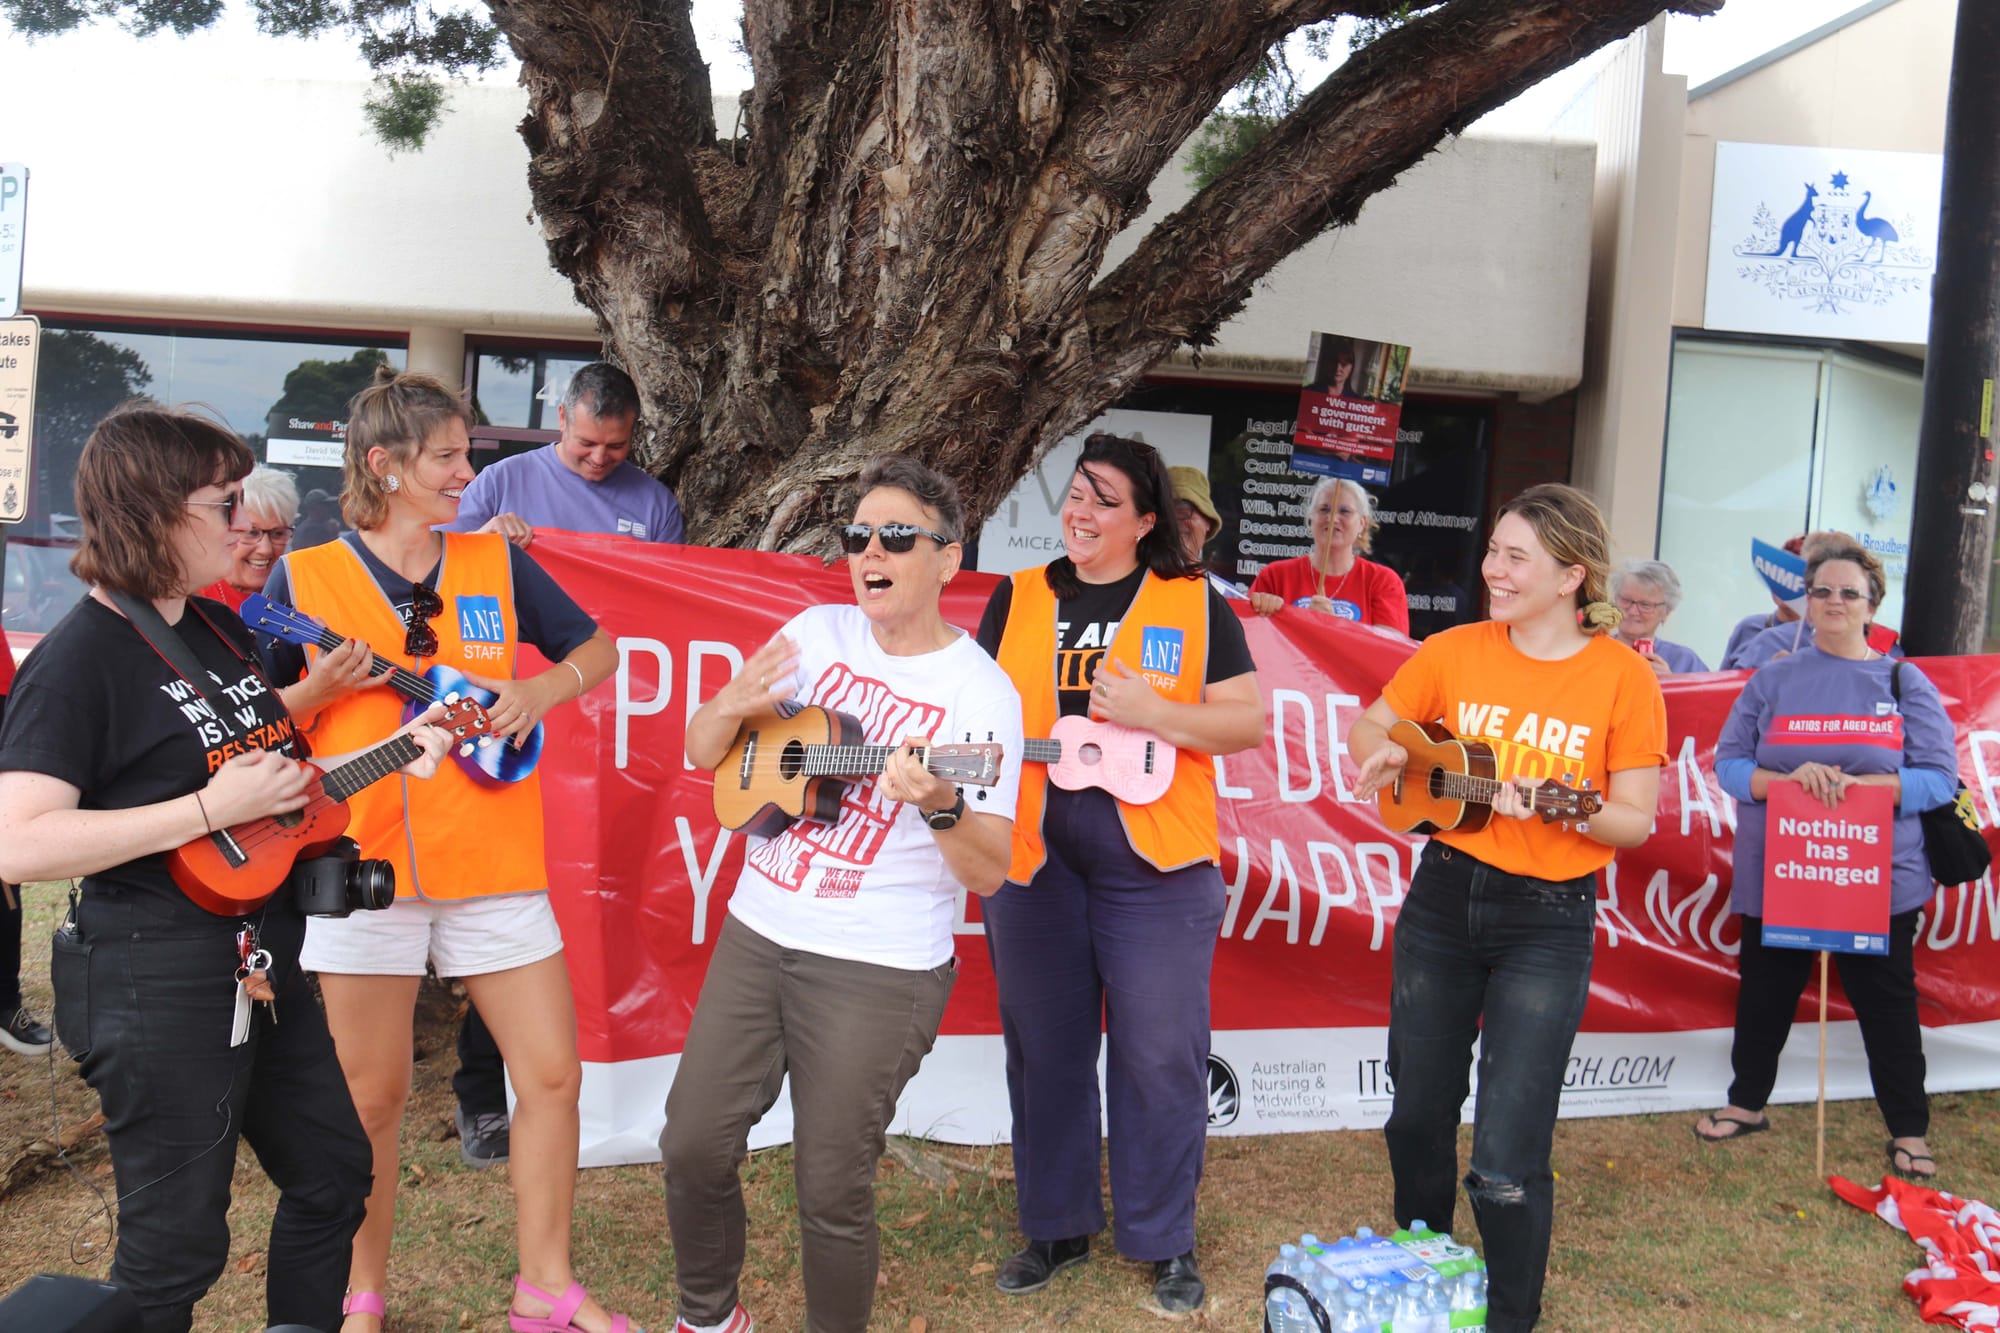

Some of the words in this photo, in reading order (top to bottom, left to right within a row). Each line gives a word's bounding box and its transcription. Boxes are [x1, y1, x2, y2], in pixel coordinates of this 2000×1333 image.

[1311, 406, 1319, 414] a
[1320, 407, 1387, 426] government
[1348, 402, 1376, 414] need
[1246, 417, 1288, 436] Legal
[1319, 417, 1345, 429] with
[1244, 458, 1287, 475] Court
[1241, 498, 1276, 517] Wills,
[1398, 510, 1414, 525] of
[1414, 511, 1478, 532] Attorney
[1754, 555, 1805, 593] ANMF
[462, 609, 501, 641] ANF
[463, 644, 505, 660] STAFF
[1142, 639, 1181, 673] ANF
[1142, 673, 1178, 691] STAFF
[1458, 701, 1510, 738] WE
[1513, 712, 1592, 760] ARE
[1788, 719, 1821, 732] RATIOS
[1823, 719, 1841, 732] FOR
[1842, 718, 1866, 731] AGED
[1868, 720, 1894, 733] CARE
[1778, 817, 1879, 844] Nothing
[1805, 840, 1849, 861] has
[825, 867, 841, 880] WE
[842, 871, 865, 881] ARE
[1774, 861, 1880, 886] changed
[818, 889, 856, 898] WOMEN
[819, 878, 861, 891] UNION
[1251, 1059, 1326, 1075] Australian
[1252, 1076, 1310, 1093] Nursing
[1315, 1075, 1326, 1088] &
[1253, 1092, 1327, 1109] Midwifery
[1256, 1108, 1340, 1120] Federation
